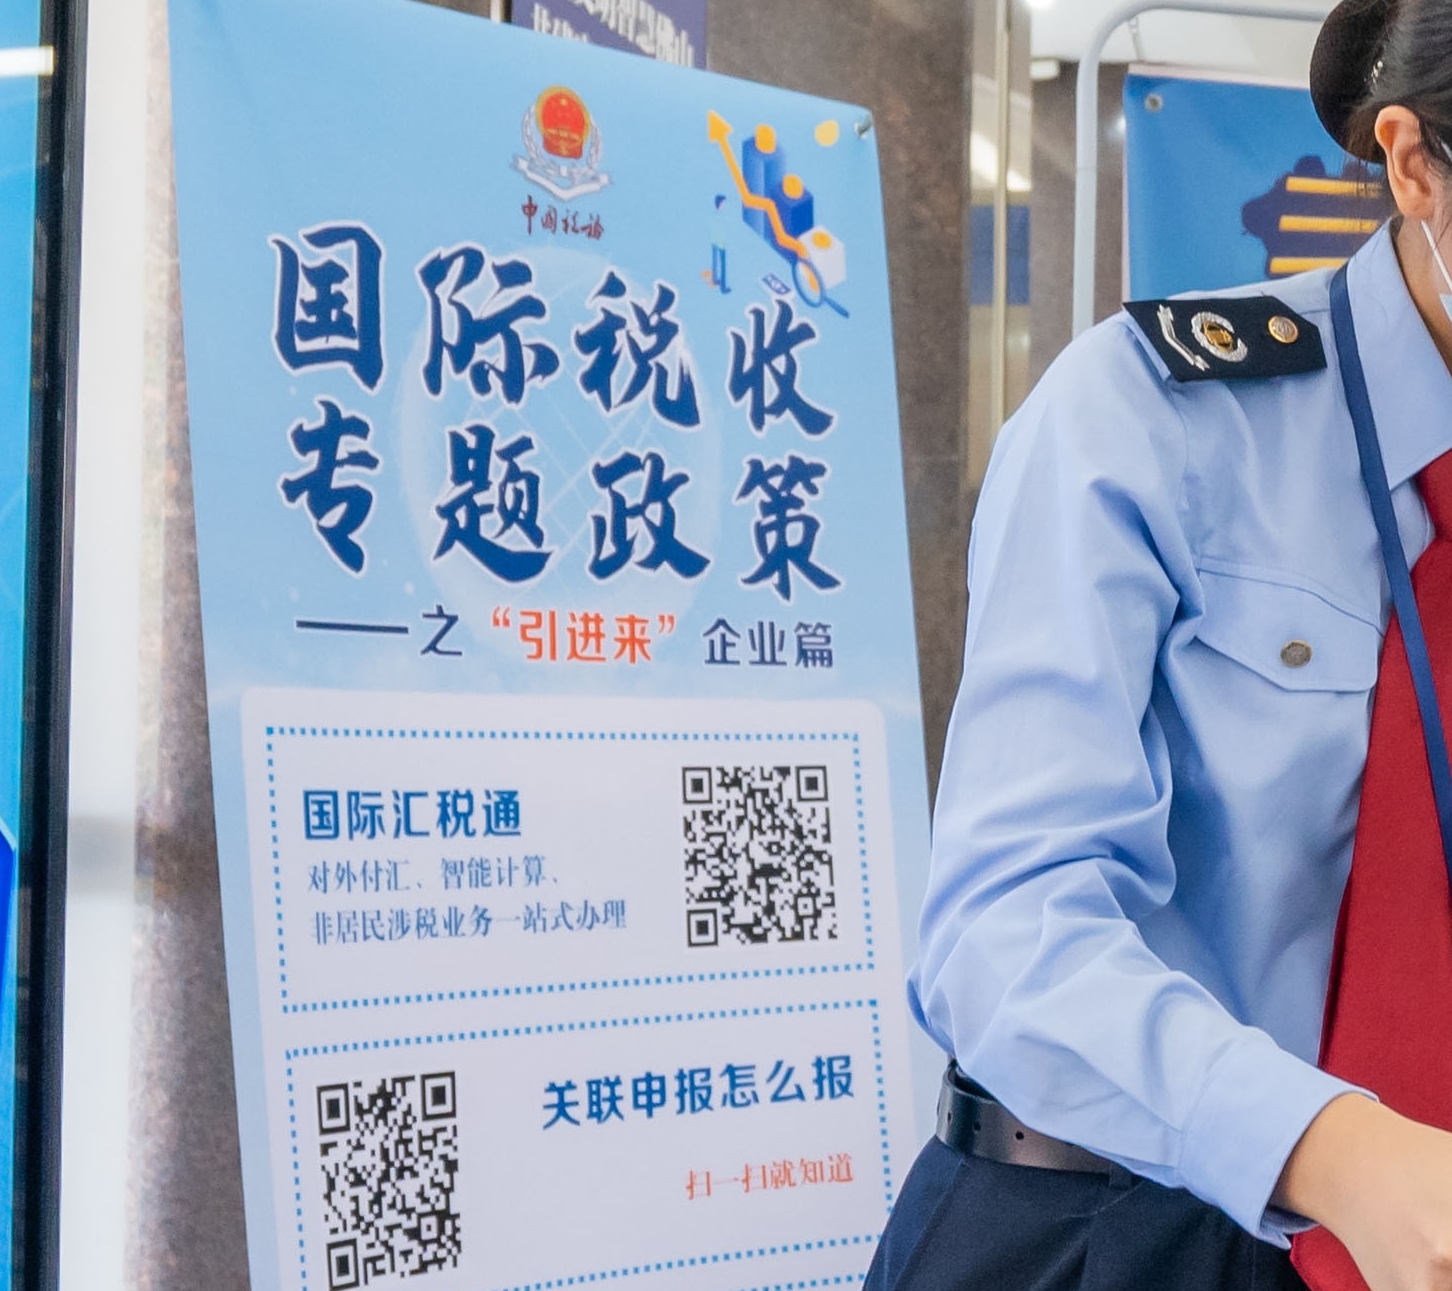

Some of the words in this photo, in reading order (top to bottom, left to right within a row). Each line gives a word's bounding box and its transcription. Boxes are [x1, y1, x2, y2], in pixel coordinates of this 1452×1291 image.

[270, 220, 839, 437] 国际税收
[280, 399, 842, 602] 专题政策
[302, 788, 522, 840] 国际汇税通
[307, 854, 560, 894] 对外付汇、智能计算、
[309, 898, 628, 946] 非居民涉税业务一站式办理
[541, 1054, 854, 1130] 关联申报怎么报
[685, 1152, 854, 1199] 扫一扫就知道
